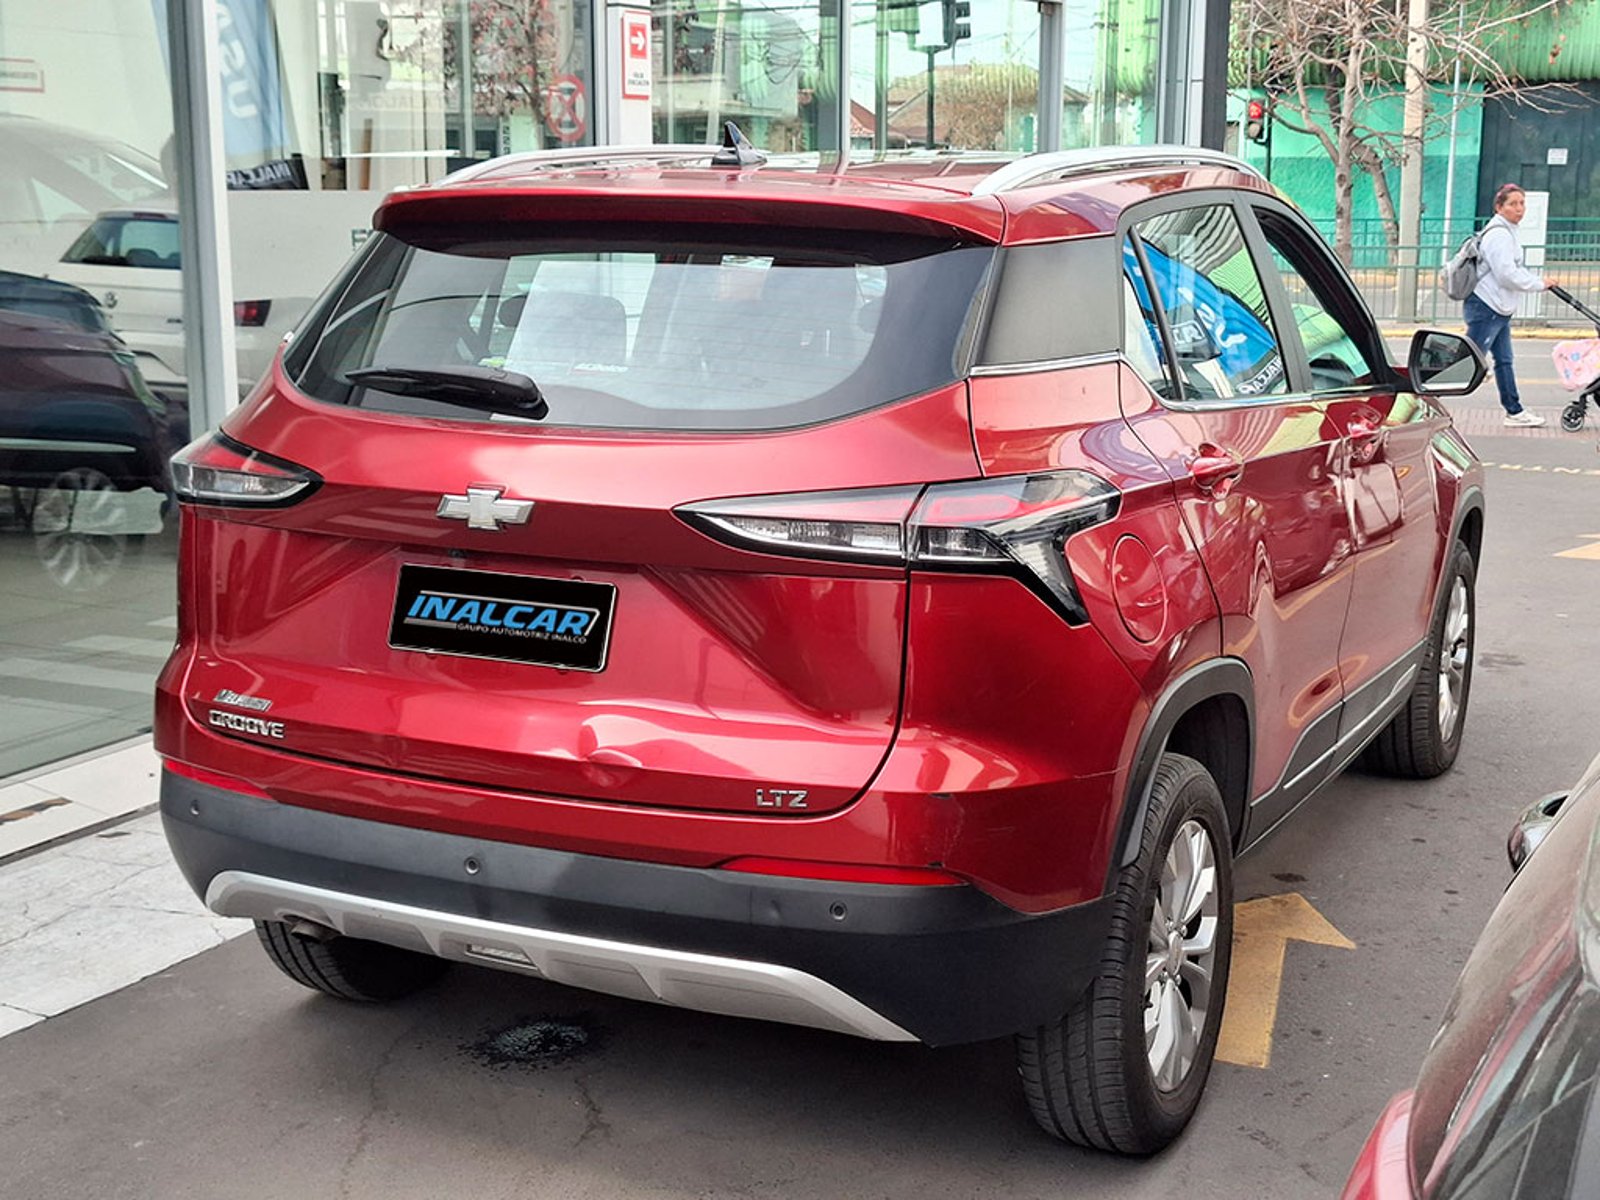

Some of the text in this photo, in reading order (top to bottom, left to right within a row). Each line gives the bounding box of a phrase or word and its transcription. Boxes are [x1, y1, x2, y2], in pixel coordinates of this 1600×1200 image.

[407, 594, 591, 636] INALCAR
[457, 622, 587, 645] GRUPO AUTOMOTRIZ INALCO
[208, 709, 285, 739] GROOVE
[755, 788, 808, 808] LTZ
